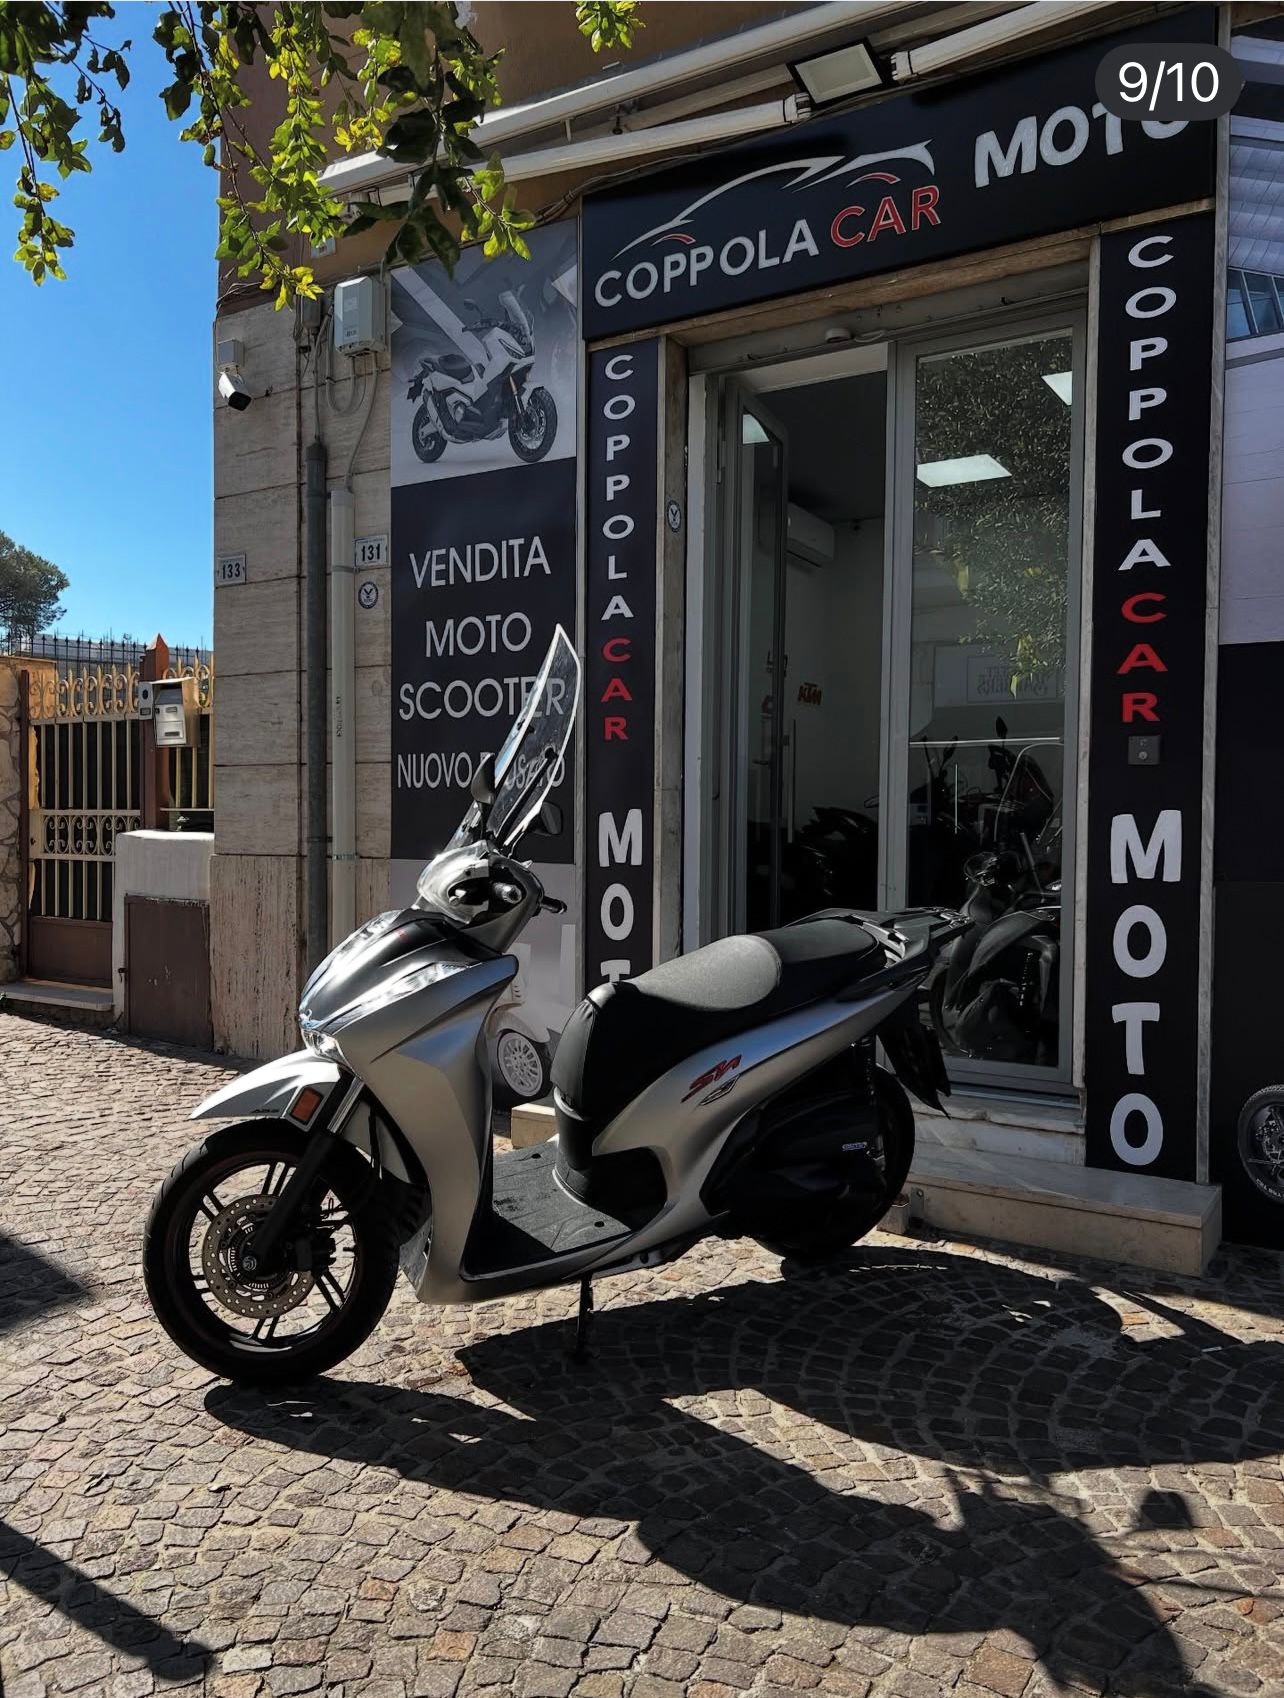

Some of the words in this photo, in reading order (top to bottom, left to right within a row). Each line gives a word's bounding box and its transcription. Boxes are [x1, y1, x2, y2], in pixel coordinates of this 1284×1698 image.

[594, 219, 819, 308] COPPOLA
[829, 185, 942, 249] CAR
[1117, 235, 1177, 571] COPPOLA
[600, 354, 636, 621] COPPOLA
[222, 562, 241, 580] 133
[361, 543, 381, 562] 131
[409, 535, 552, 589] VENDITA
[425, 611, 532, 658] MOTO
[1117, 592, 1168, 722] CAR
[601, 638, 633, 740] CAR
[397, 752, 475, 789] NUOVO
[1109, 809, 1183, 1166] MOTO
